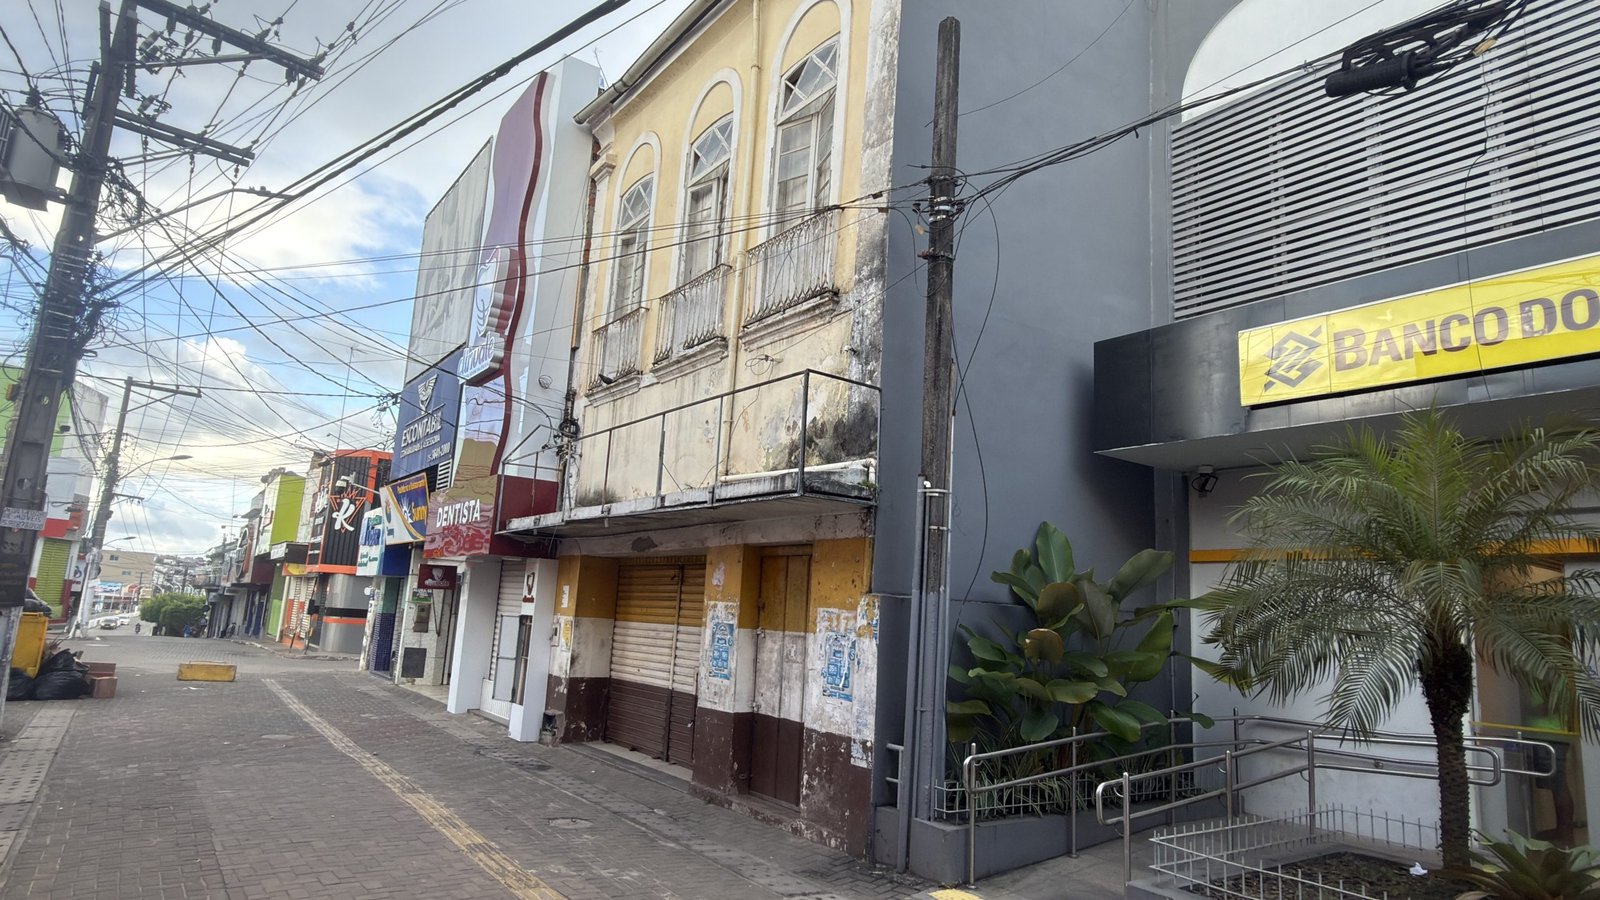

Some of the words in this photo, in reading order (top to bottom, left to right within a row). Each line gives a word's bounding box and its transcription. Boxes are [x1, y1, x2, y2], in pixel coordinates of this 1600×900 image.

[1333, 306, 1509, 372] BANCO
[1519, 288, 1600, 339] DO
[332, 498, 355, 531] K
[436, 498, 480, 528] DENTISTA
